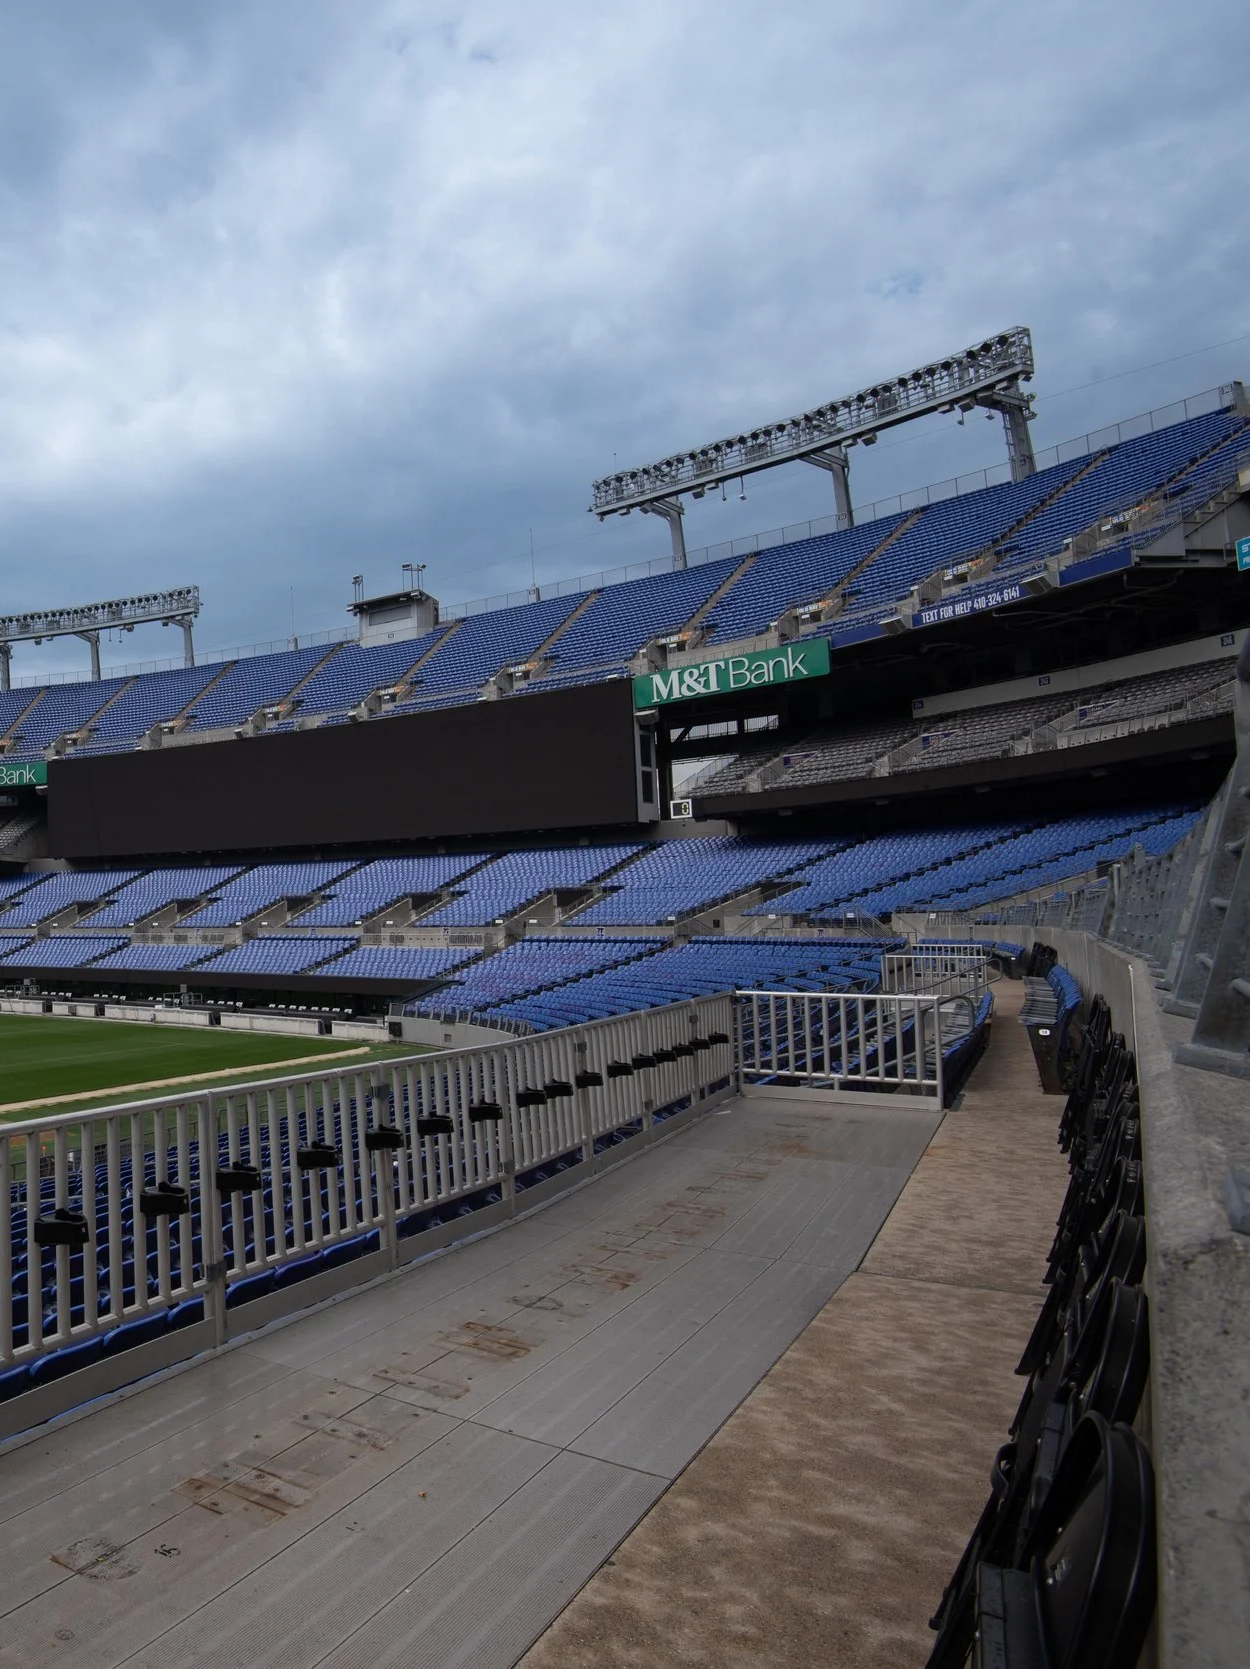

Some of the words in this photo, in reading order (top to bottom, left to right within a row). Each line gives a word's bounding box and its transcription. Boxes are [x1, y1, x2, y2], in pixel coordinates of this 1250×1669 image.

[921, 609, 938, 624] TEXT
[940, 605, 954, 620] FOR
[954, 601, 972, 615] HELP
[973, 585, 1020, 611] 410-324-6141
[650, 660, 726, 704] M&T
[727, 646, 809, 690] Bank
[682, 803, 690, 815] 0
